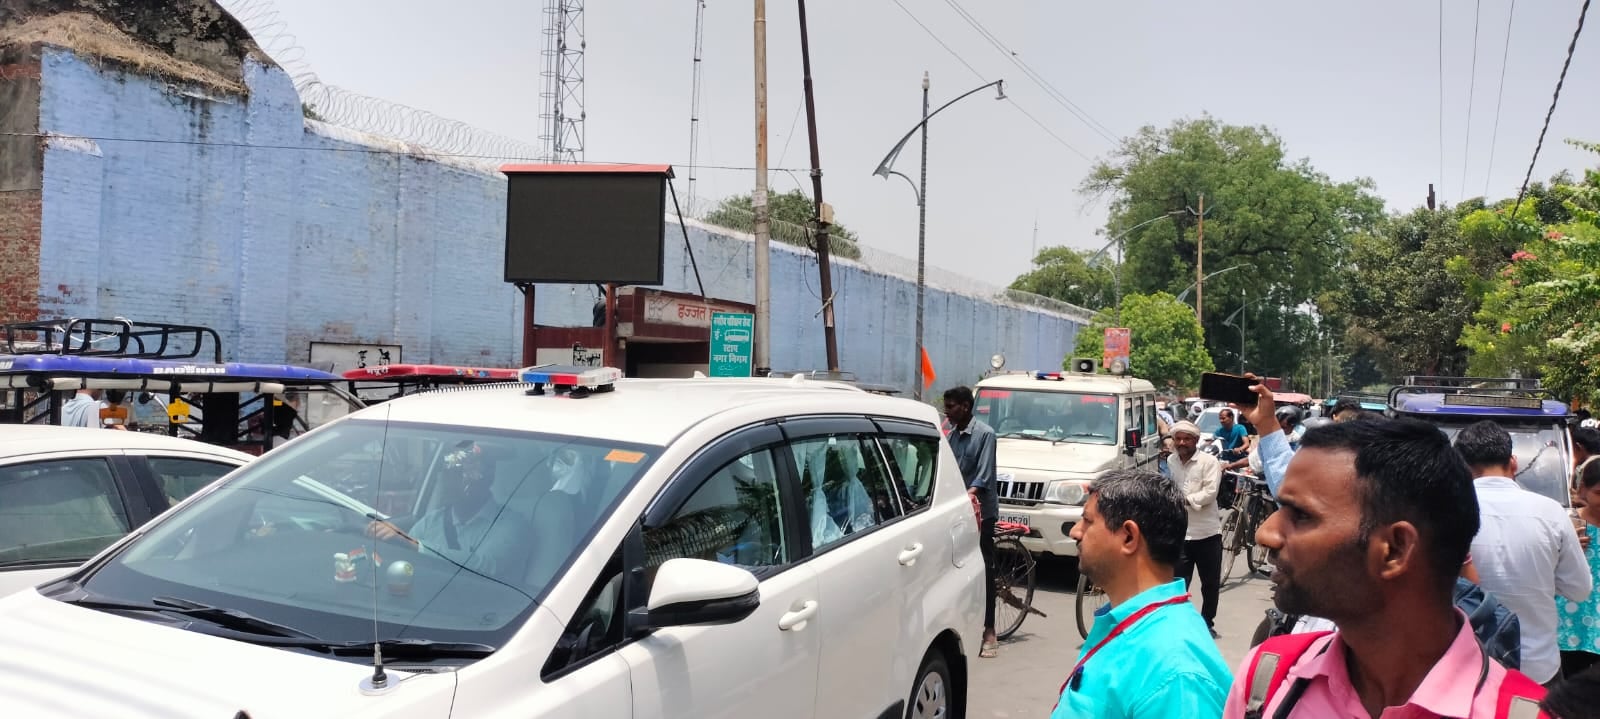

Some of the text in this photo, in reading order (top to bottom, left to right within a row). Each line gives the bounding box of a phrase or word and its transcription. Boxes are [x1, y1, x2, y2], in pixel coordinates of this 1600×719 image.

[678, 303, 706, 320] इज्जत
[712, 352, 748, 363] नगर निगम
